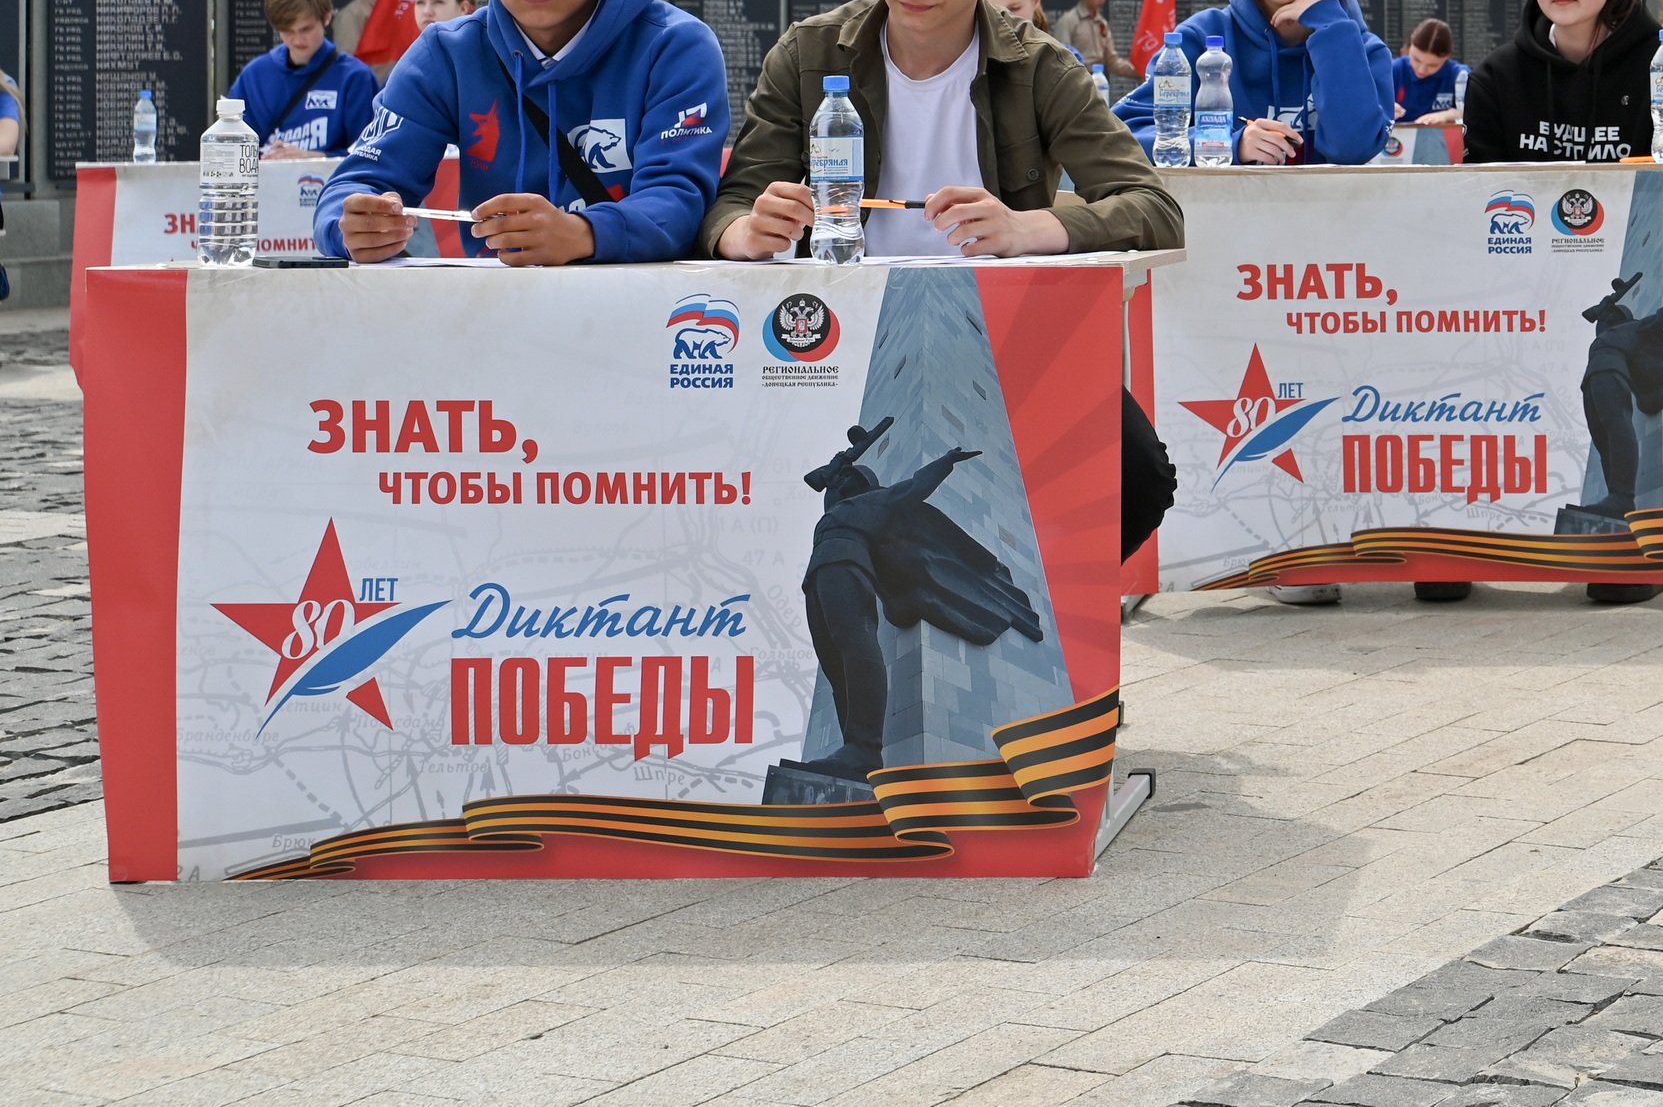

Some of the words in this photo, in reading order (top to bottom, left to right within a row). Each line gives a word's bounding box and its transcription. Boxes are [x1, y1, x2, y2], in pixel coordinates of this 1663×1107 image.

[661, 126, 713, 140] ПОЛИТИКА
[1488, 237, 1532, 245] ЕДИНАЯ
[1488, 246, 1532, 254] РОССИЯ
[1237, 263, 1398, 305] ЗНАТЬ,
[1286, 311, 1387, 334] ЧТОБЫ
[1397, 310, 1546, 333] ПОМНИТЬ!
[670, 364, 734, 375] ЕДИНАЯ
[670, 377, 734, 388] РОССИЯ
[762, 366, 839, 374] РЕГИОНАЛЬНОЕ
[1278, 382, 1304, 399] ЛЕТ
[1342, 385, 1545, 423] Диктант
[307, 399, 539, 464] ЗНАТЬ,
[1227, 396, 1277, 438] 80
[1342, 434, 1547, 505] ПОБЕДЫ
[378, 471, 523, 505] ЧТОБЫ
[536, 470, 752, 505] ПОМНИТЬ!
[359, 578, 399, 602] ЛЕТ
[451, 582, 751, 640] Диктант
[282, 599, 355, 660] 80
[451, 655, 754, 761] ПОБЕДЫ
